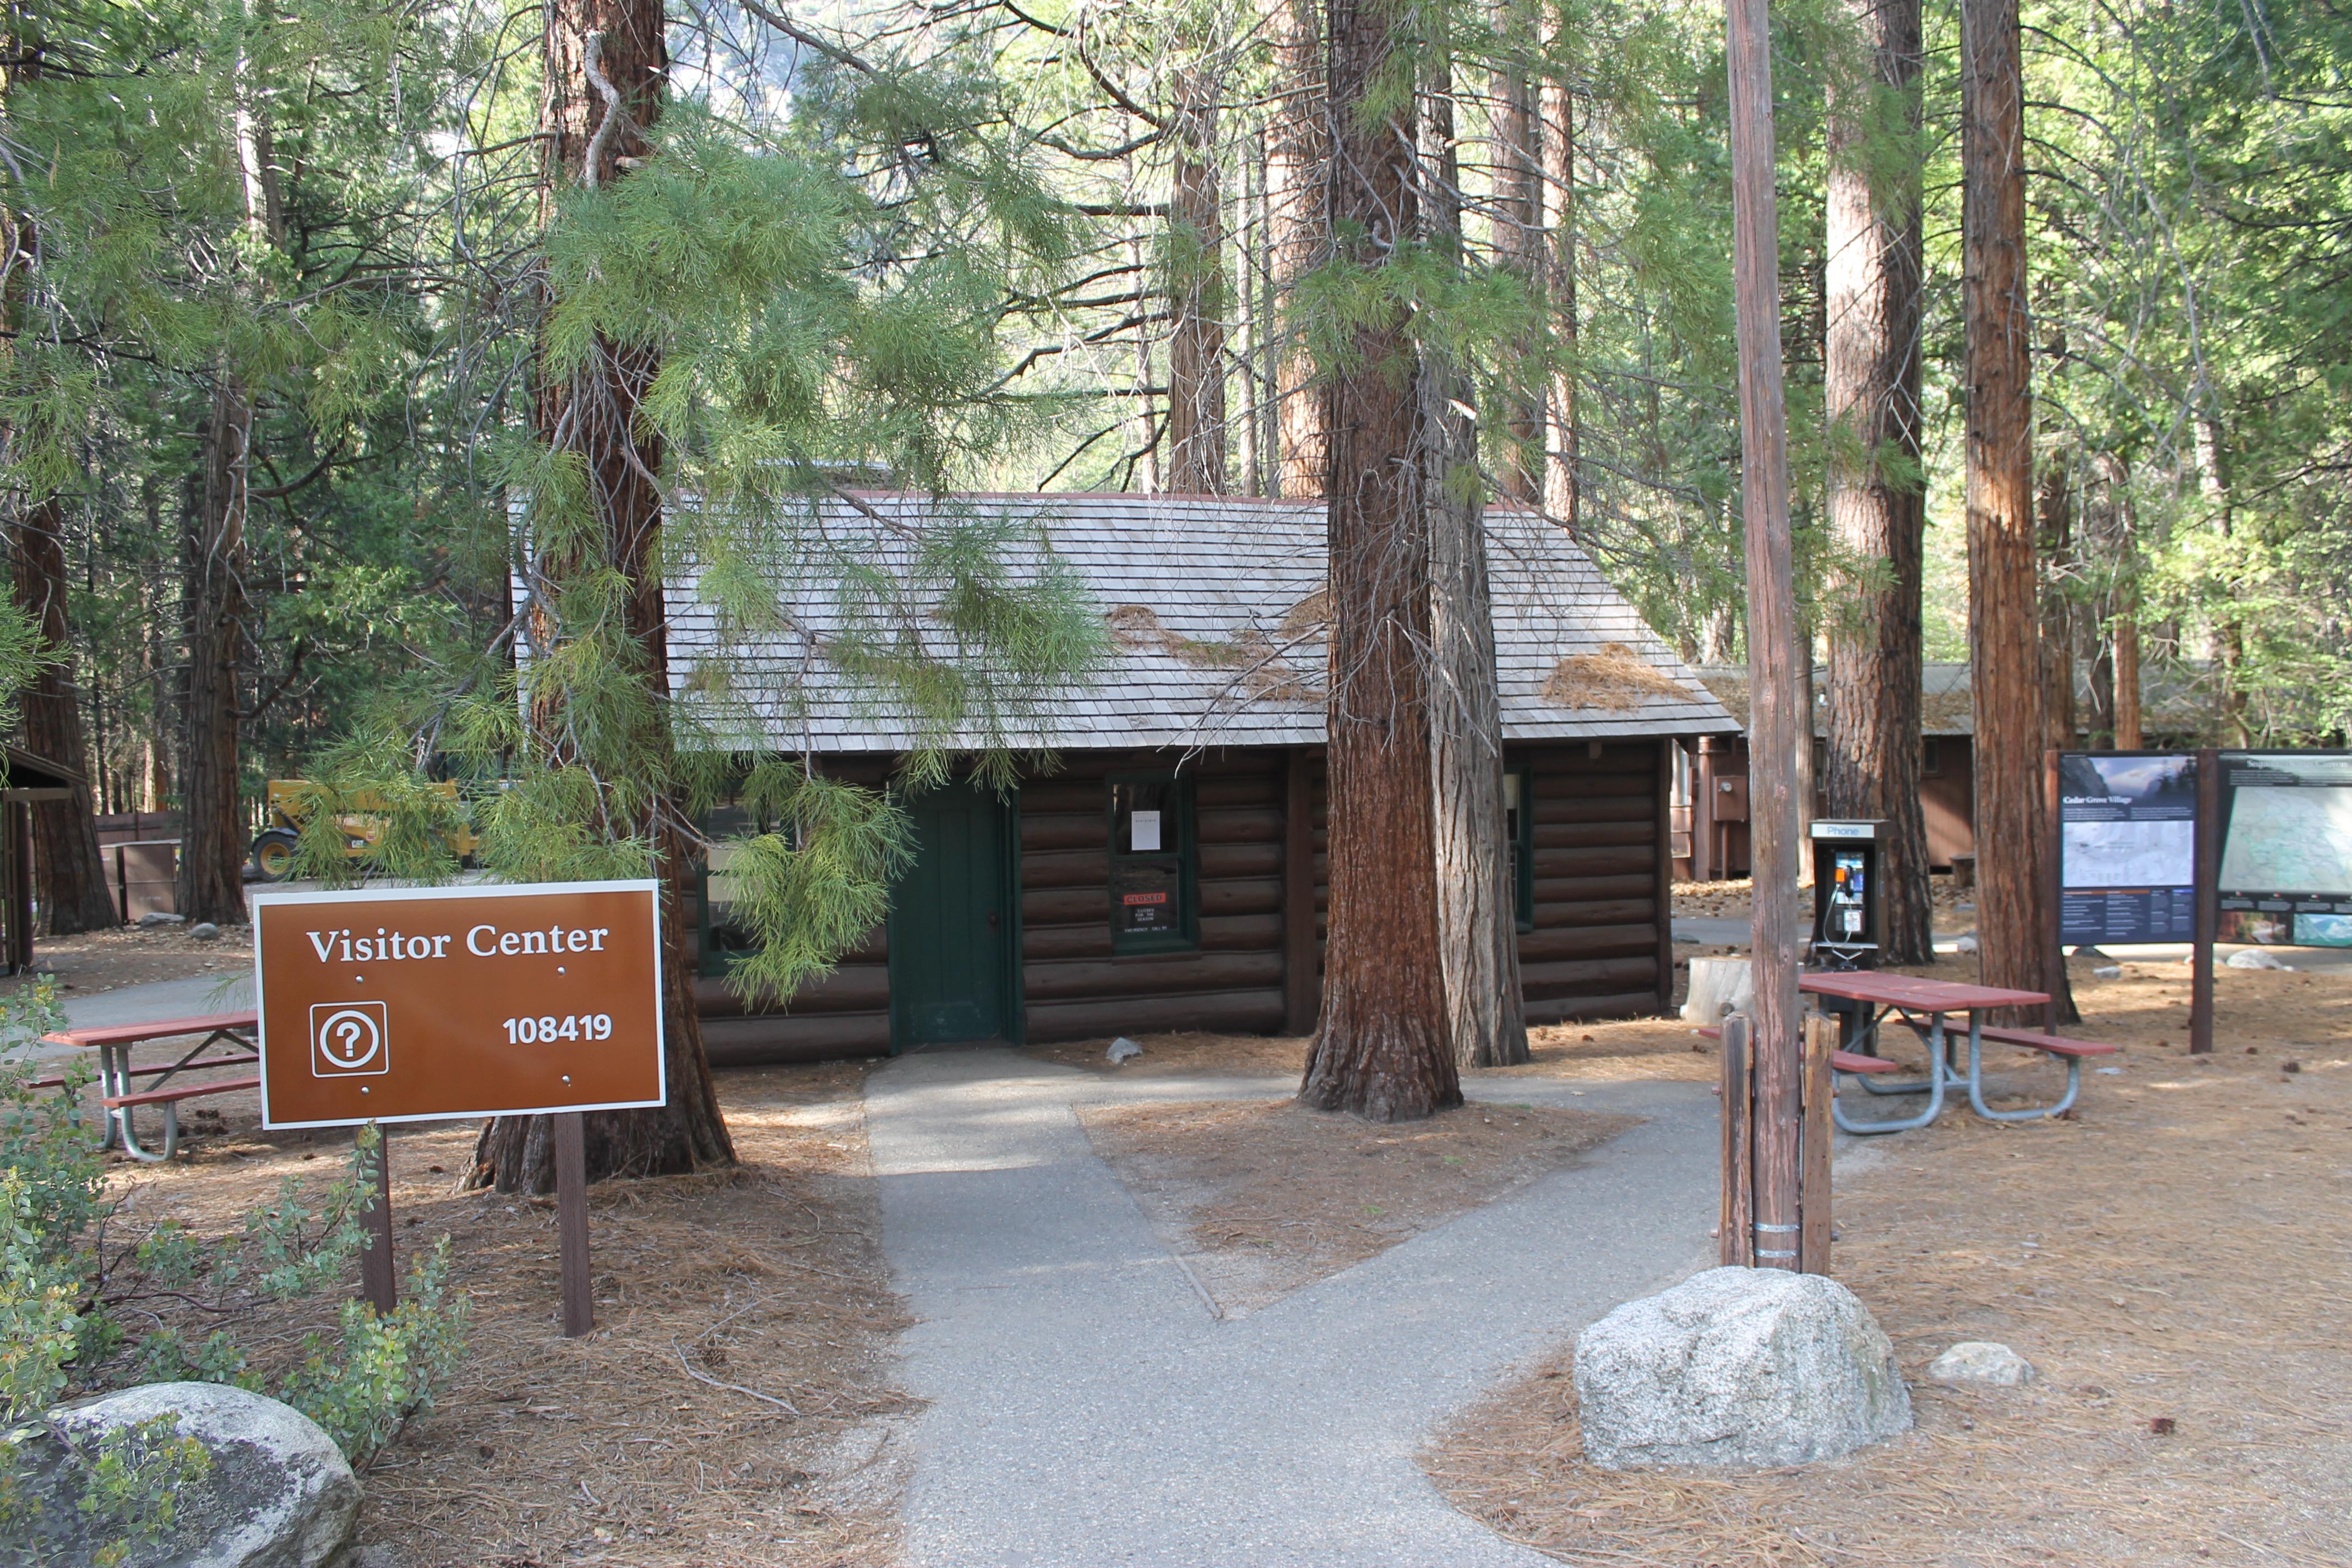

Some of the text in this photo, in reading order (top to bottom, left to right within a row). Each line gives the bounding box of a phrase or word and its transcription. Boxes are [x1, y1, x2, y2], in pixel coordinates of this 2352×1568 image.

[2062, 795, 2132, 805] Cedar Grove Village
[1827, 826, 1859, 836] Phone
[351, 840, 364, 848] CAT
[1127, 894, 1162, 903] CLOSED
[306, 924, 609, 963] Visitor Center
[502, 1014, 612, 1044] 108419
